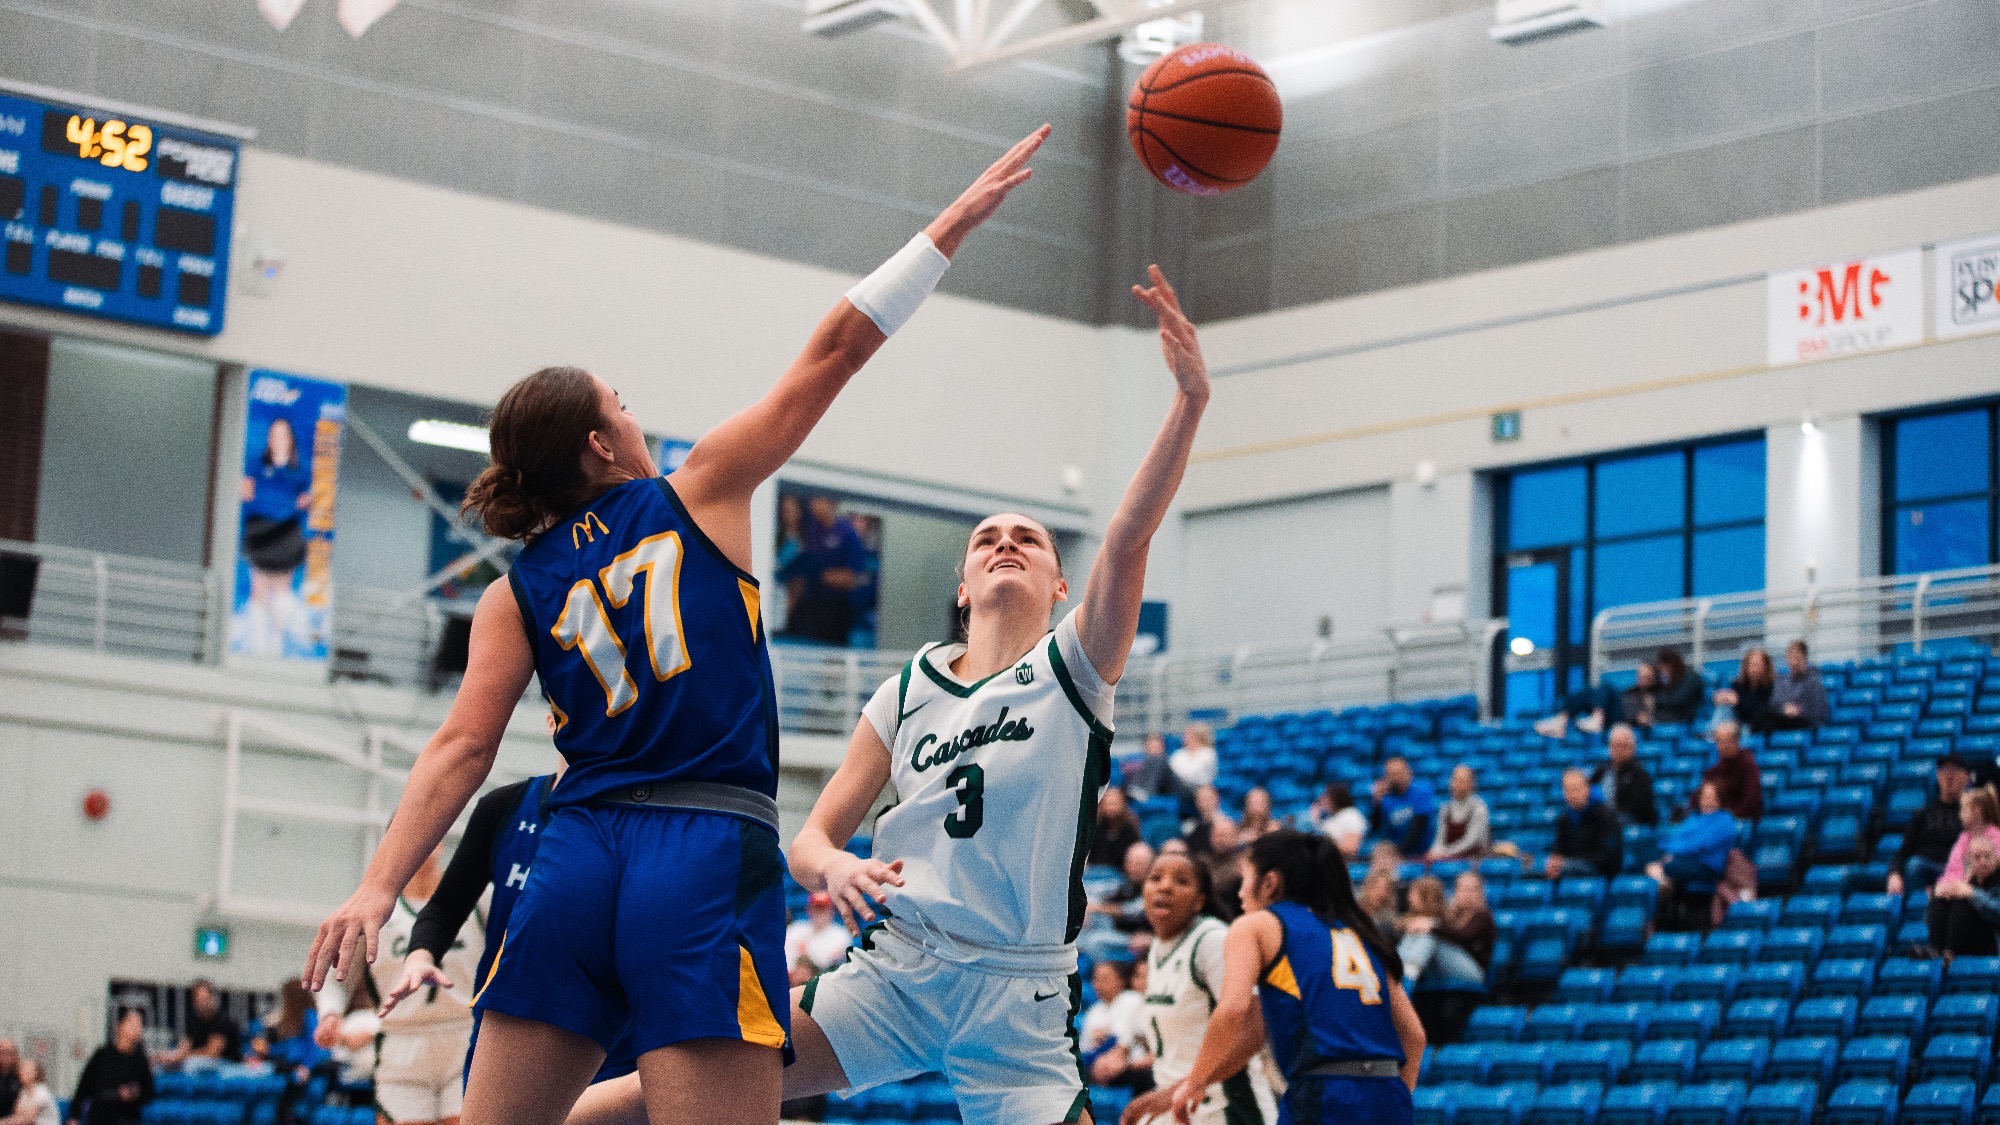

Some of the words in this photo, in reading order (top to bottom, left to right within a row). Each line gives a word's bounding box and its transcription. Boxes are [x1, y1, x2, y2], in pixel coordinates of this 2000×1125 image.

[66, 115, 153, 172] 4:52
[551, 530, 692, 717] 17
[911, 706, 1035, 772] Cascades
[944, 763, 984, 838] 3
[1331, 928, 1383, 1005] 4
